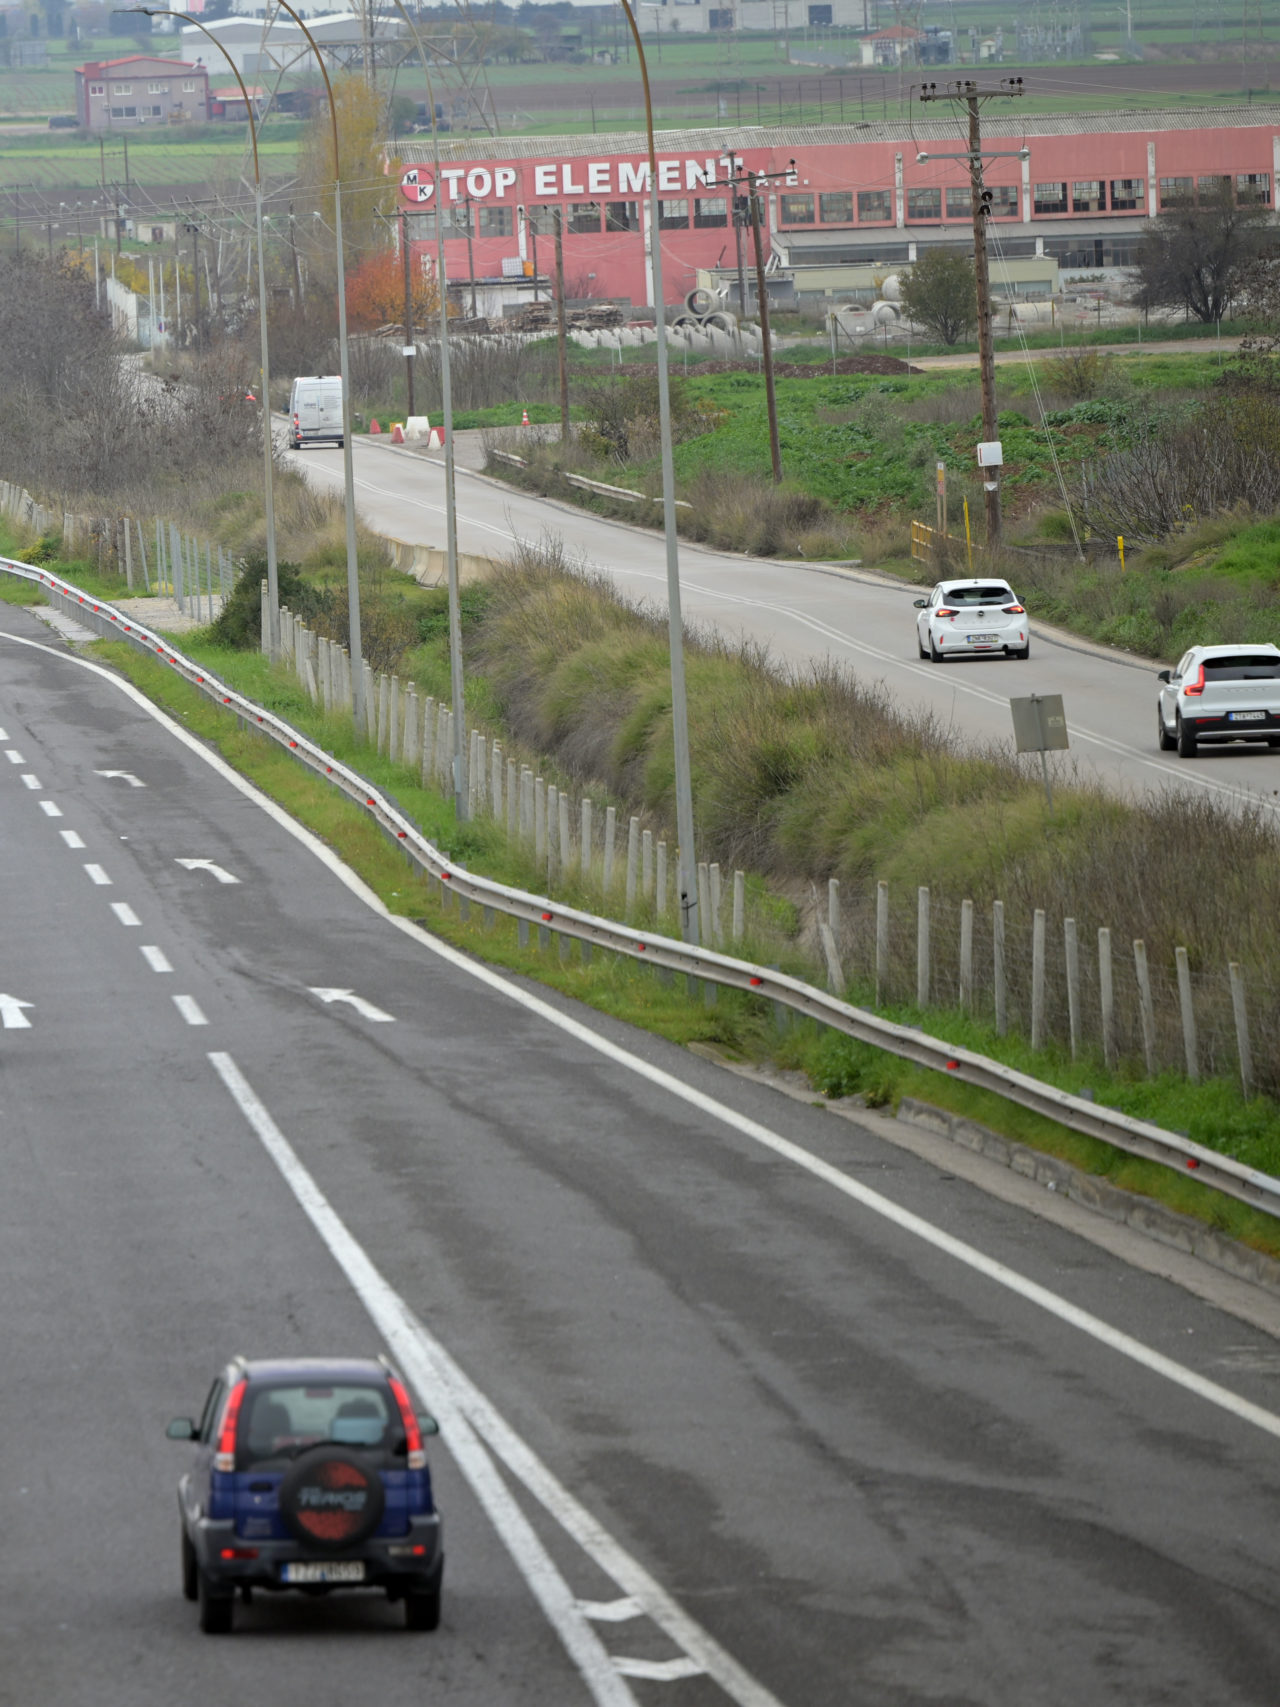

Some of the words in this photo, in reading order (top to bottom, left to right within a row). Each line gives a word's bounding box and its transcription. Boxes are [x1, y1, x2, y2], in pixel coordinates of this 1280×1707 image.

[406, 174, 418, 185] M
[441, 167, 516, 200] TOP
[535, 158, 743, 195] ELEMENT
[419, 186, 427, 197] K
